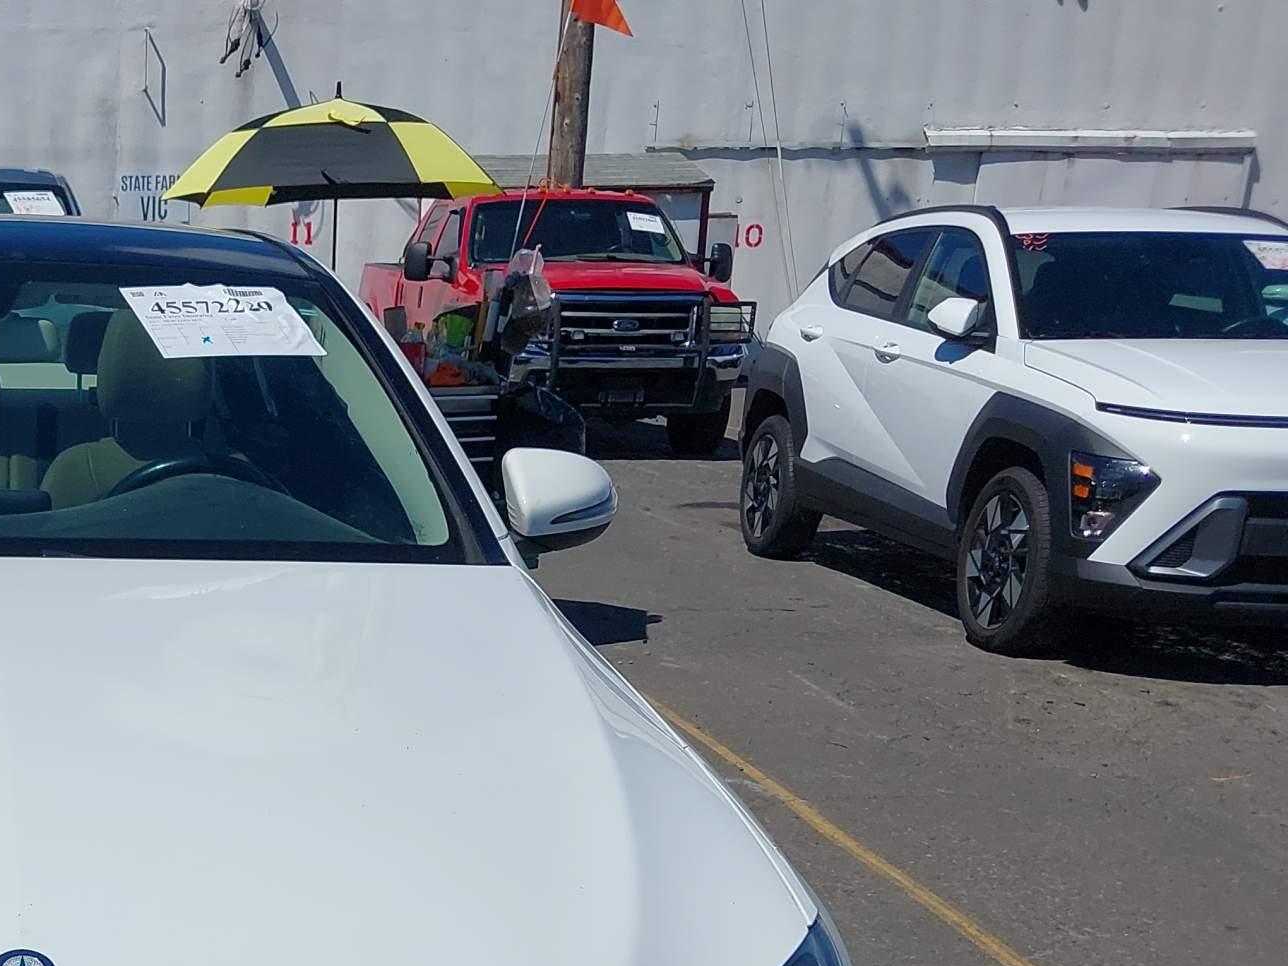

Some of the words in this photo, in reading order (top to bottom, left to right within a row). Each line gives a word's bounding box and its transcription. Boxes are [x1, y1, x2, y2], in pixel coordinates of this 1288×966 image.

[121, 176, 152, 192] STATE
[140, 196, 168, 222] VIC
[290, 222, 312, 245] 11
